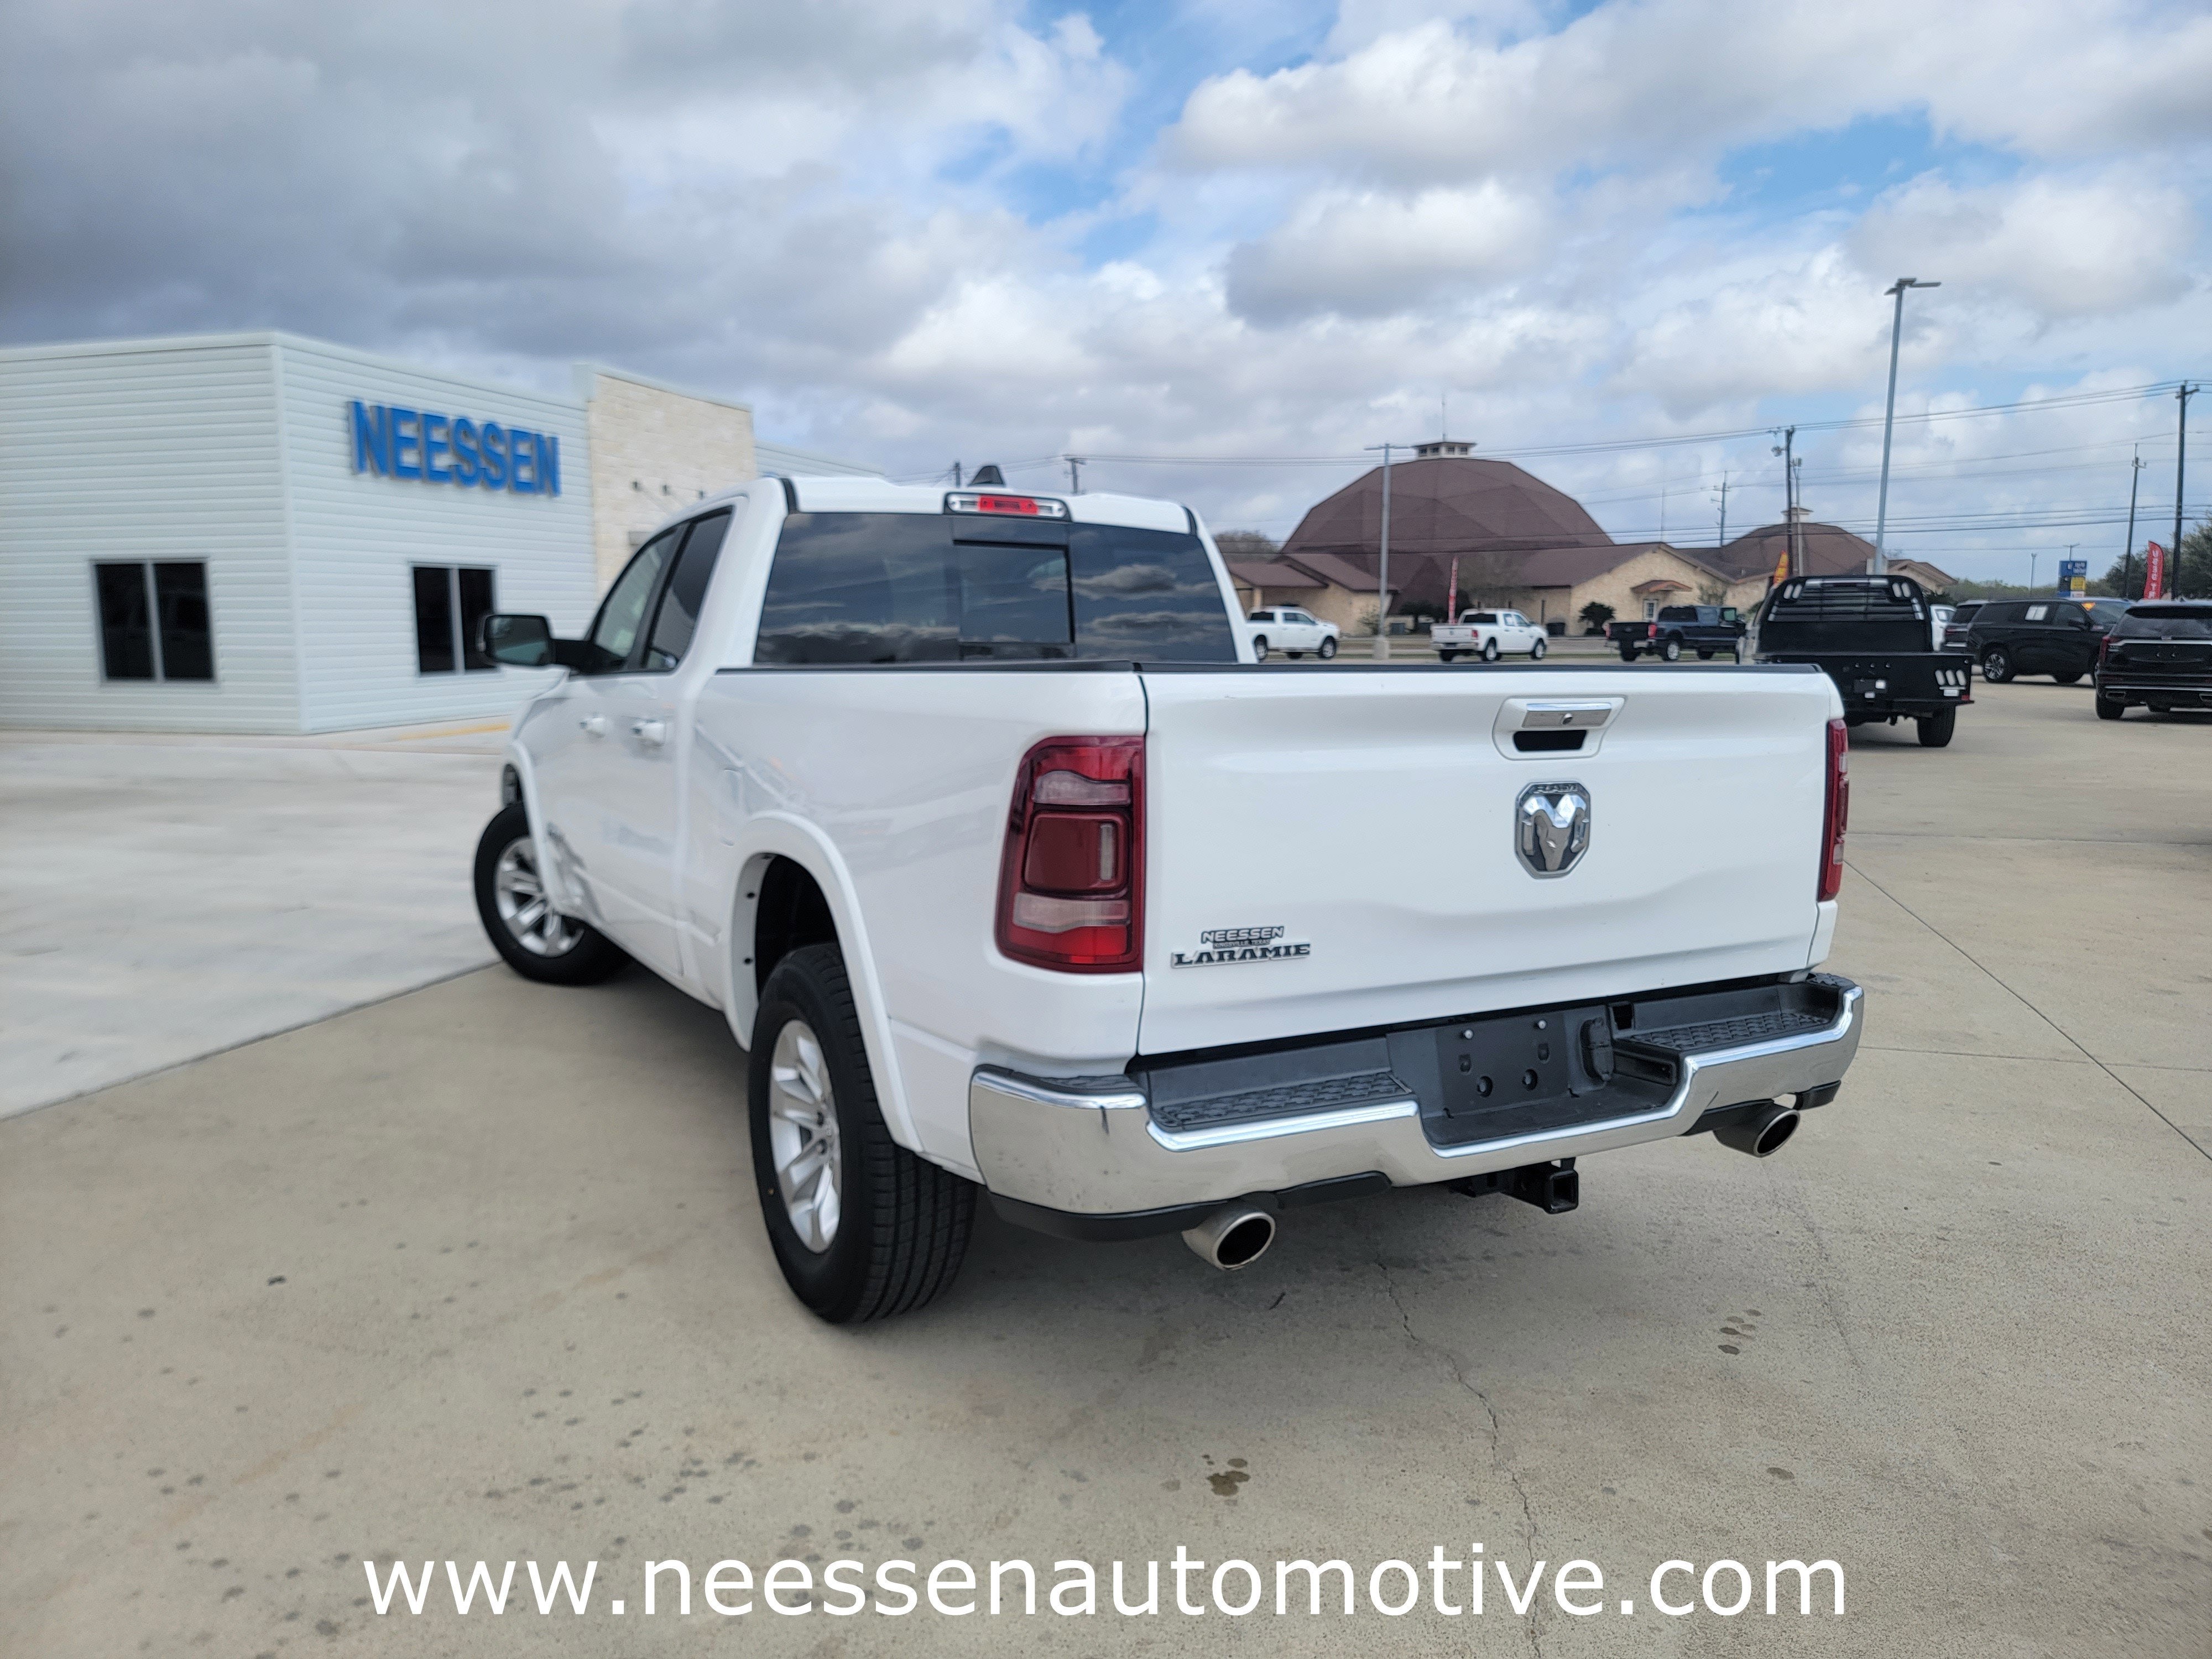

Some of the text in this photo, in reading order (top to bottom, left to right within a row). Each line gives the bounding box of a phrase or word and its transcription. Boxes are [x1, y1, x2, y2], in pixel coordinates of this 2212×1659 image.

[345, 398, 561, 497] NEESSEN
[1202, 926, 1284, 943] NEESSEN
[1173, 943, 1311, 966] LARAMIE
